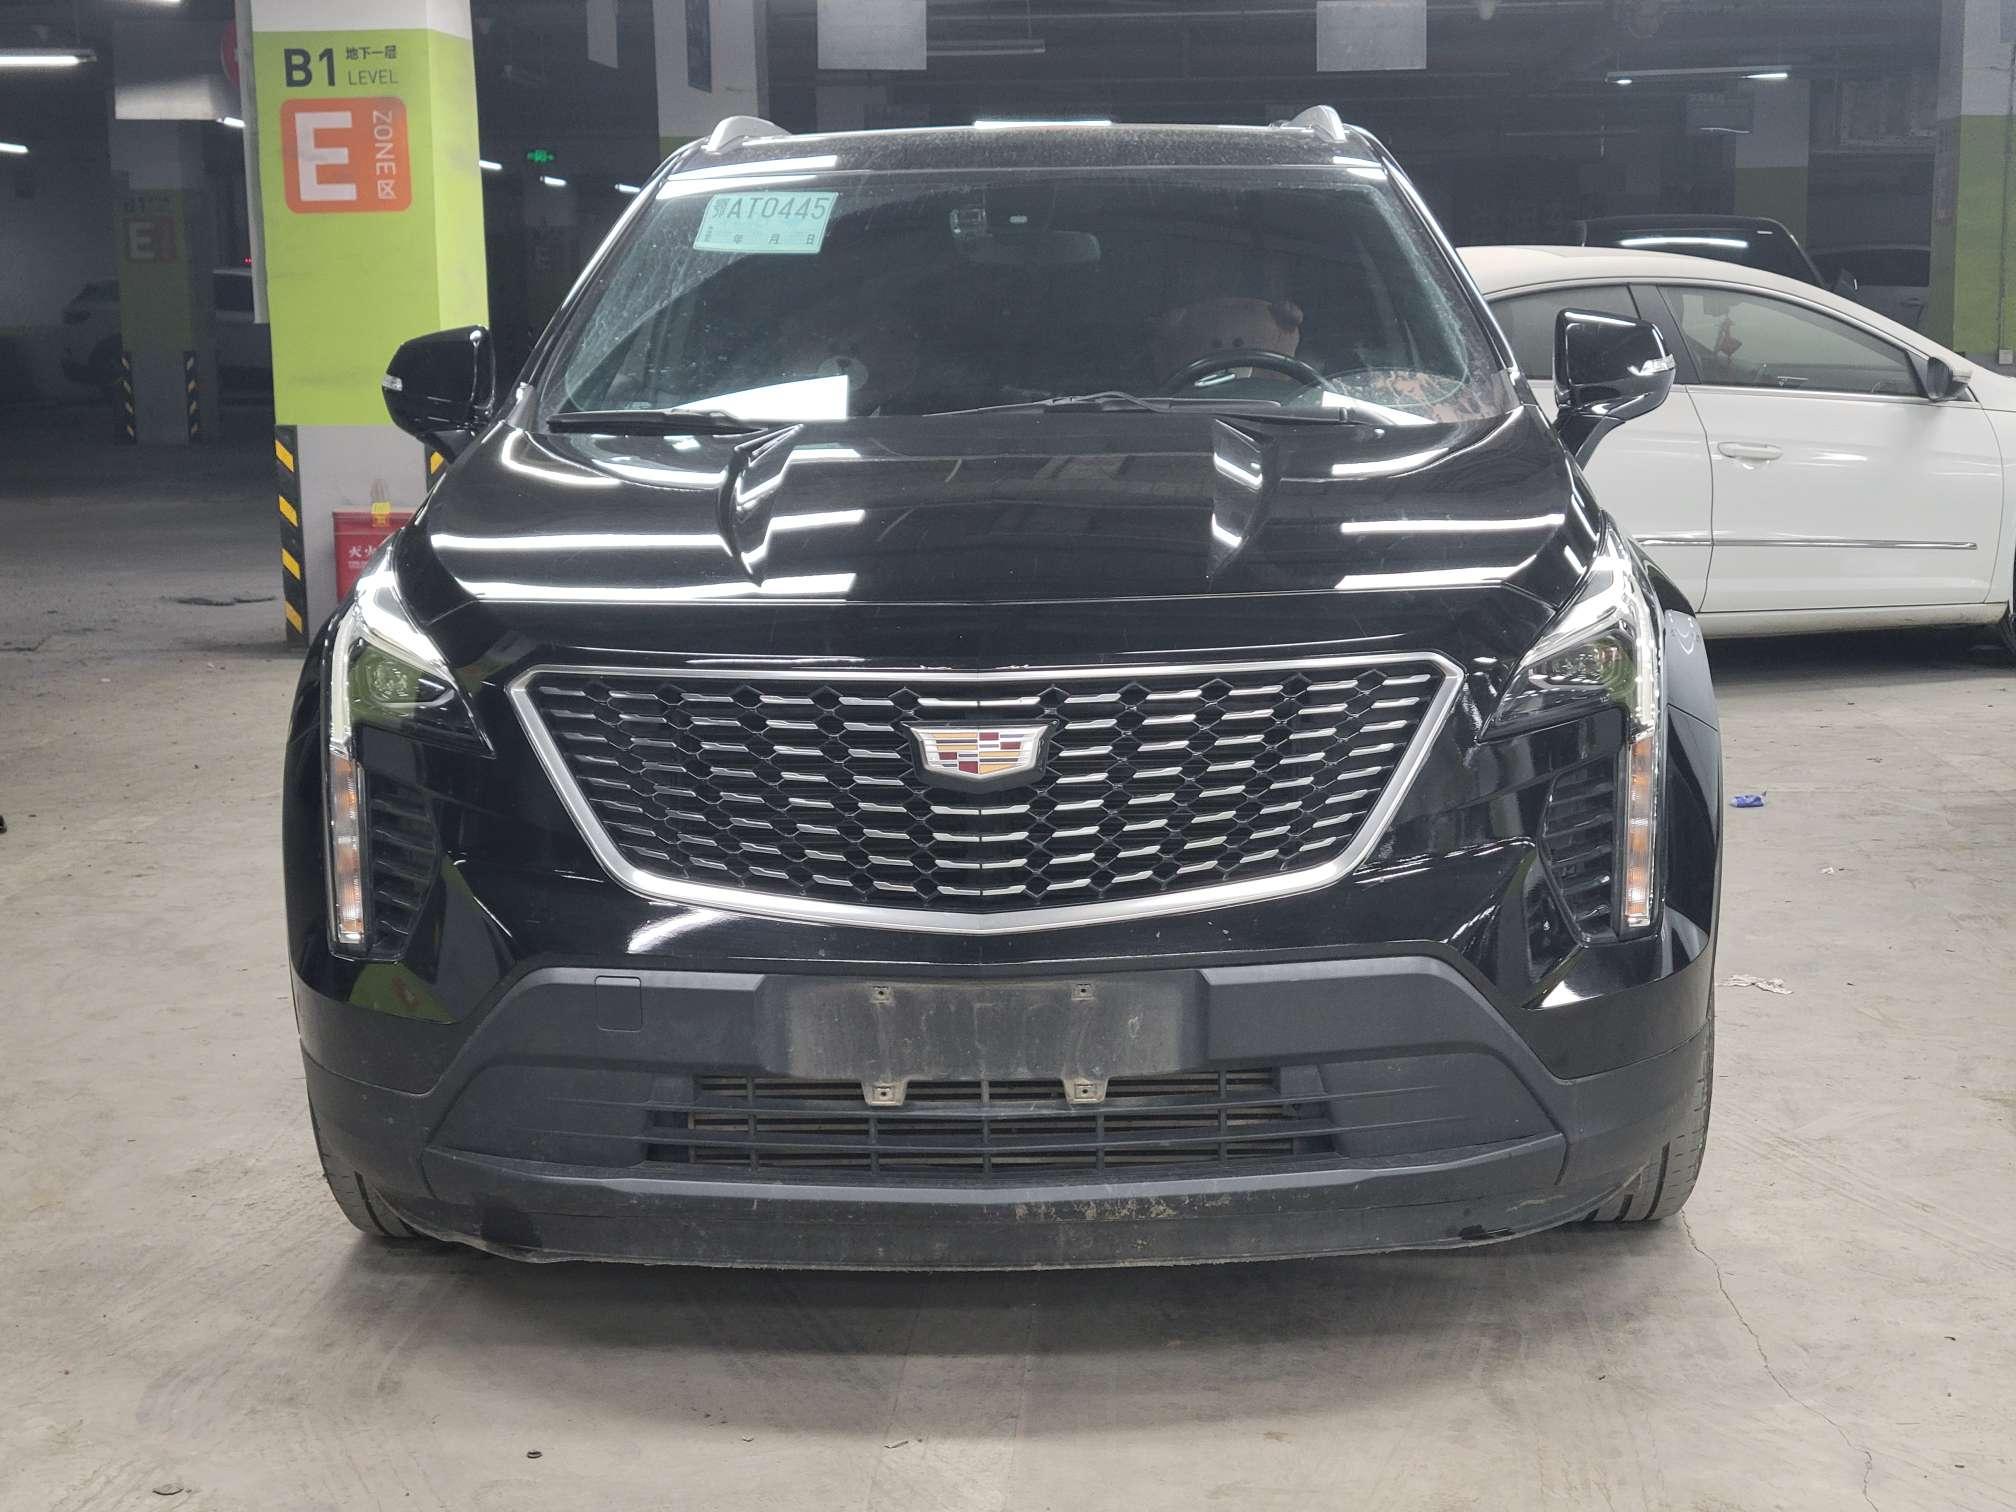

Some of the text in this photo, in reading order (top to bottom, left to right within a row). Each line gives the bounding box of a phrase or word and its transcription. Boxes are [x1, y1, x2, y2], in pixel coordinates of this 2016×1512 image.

[284, 48, 336, 88] B1
[346, 45, 397, 61] 地下一层
[348, 69, 398, 86] LEVEL
[295, 111, 357, 202] E
[373, 110, 396, 176] ZONE
